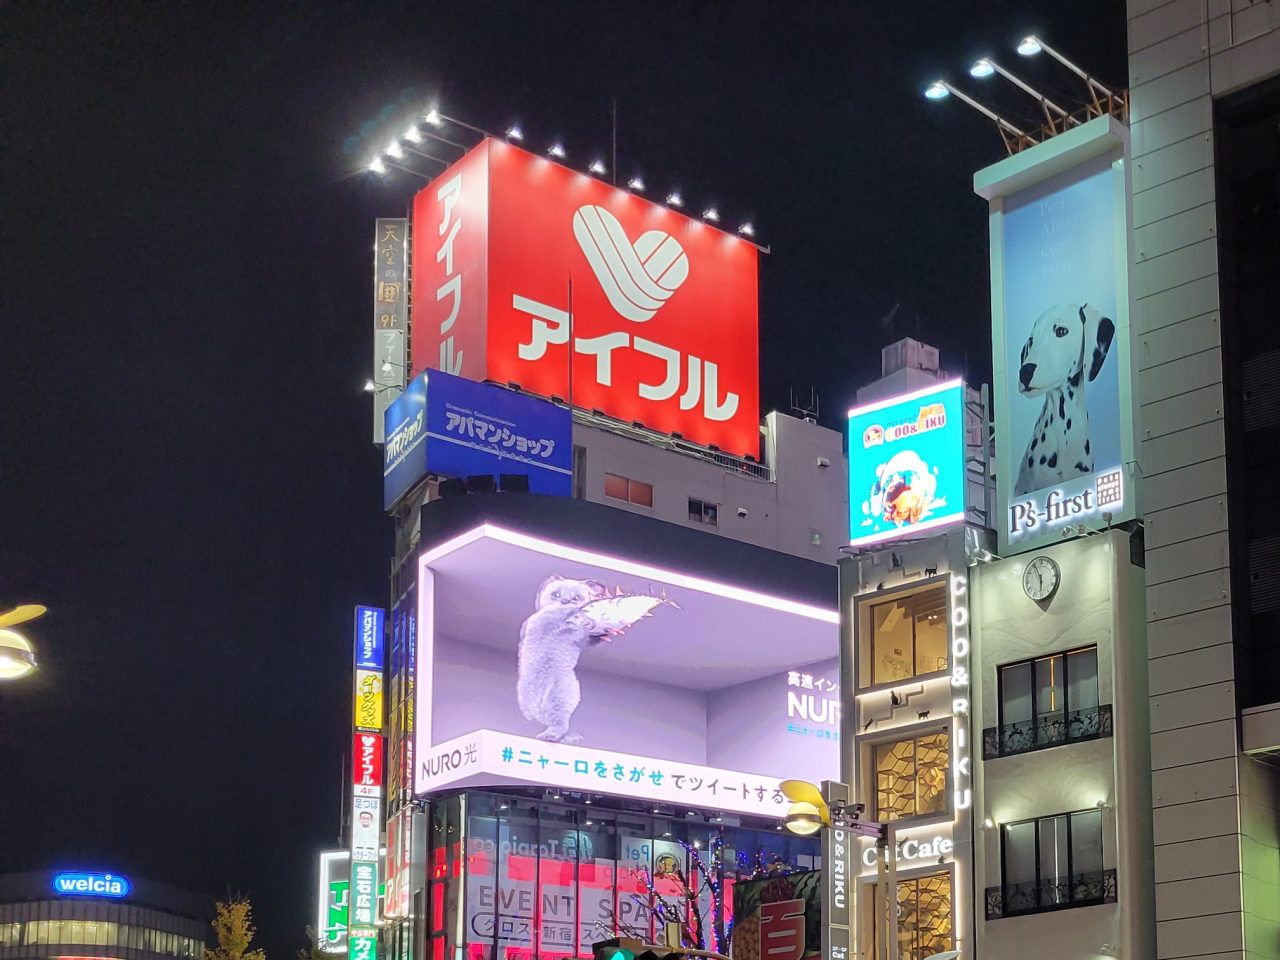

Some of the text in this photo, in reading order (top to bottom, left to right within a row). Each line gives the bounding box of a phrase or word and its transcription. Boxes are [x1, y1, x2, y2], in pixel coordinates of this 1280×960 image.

[437, 173, 464, 376] アイフル
[513, 294, 739, 421] アイフル
[446, 412, 555, 458] アパマンショップ
[362, 746, 374, 785] アイフル
[671, 773, 795, 805] でツイートする
[902, 835, 954, 860] Cafe
[60, 873, 122, 894] welcia
[355, 865, 372, 922] 宝石広場
[480, 885, 574, 918] EVENT
